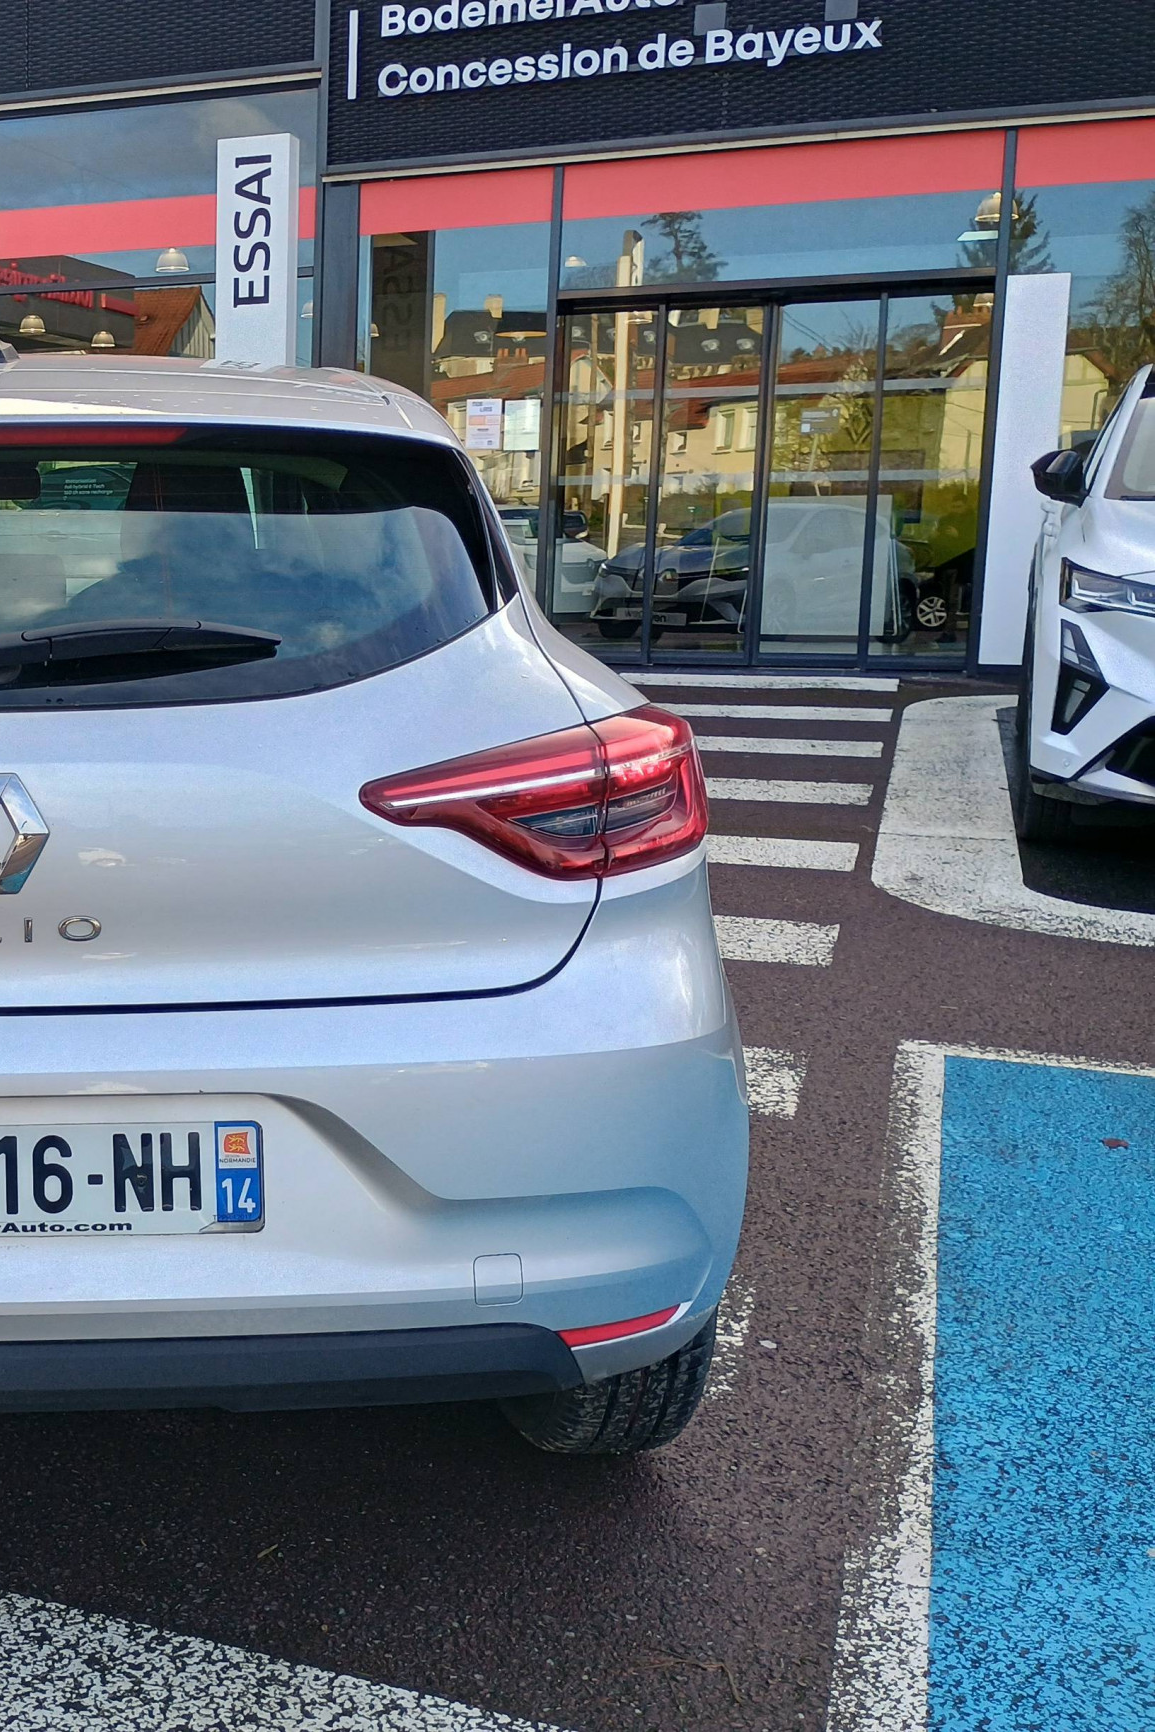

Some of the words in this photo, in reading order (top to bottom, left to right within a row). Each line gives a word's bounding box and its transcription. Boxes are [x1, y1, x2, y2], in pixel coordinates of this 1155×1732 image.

[381, 0, 677, 38] Bodemer
[377, 43, 628, 97] Concession
[638, 33, 694, 69] de
[705, 19, 883, 67] Bayeux
[233, 154, 272, 308] ESSAI
[221, 1177, 256, 1214] 14
